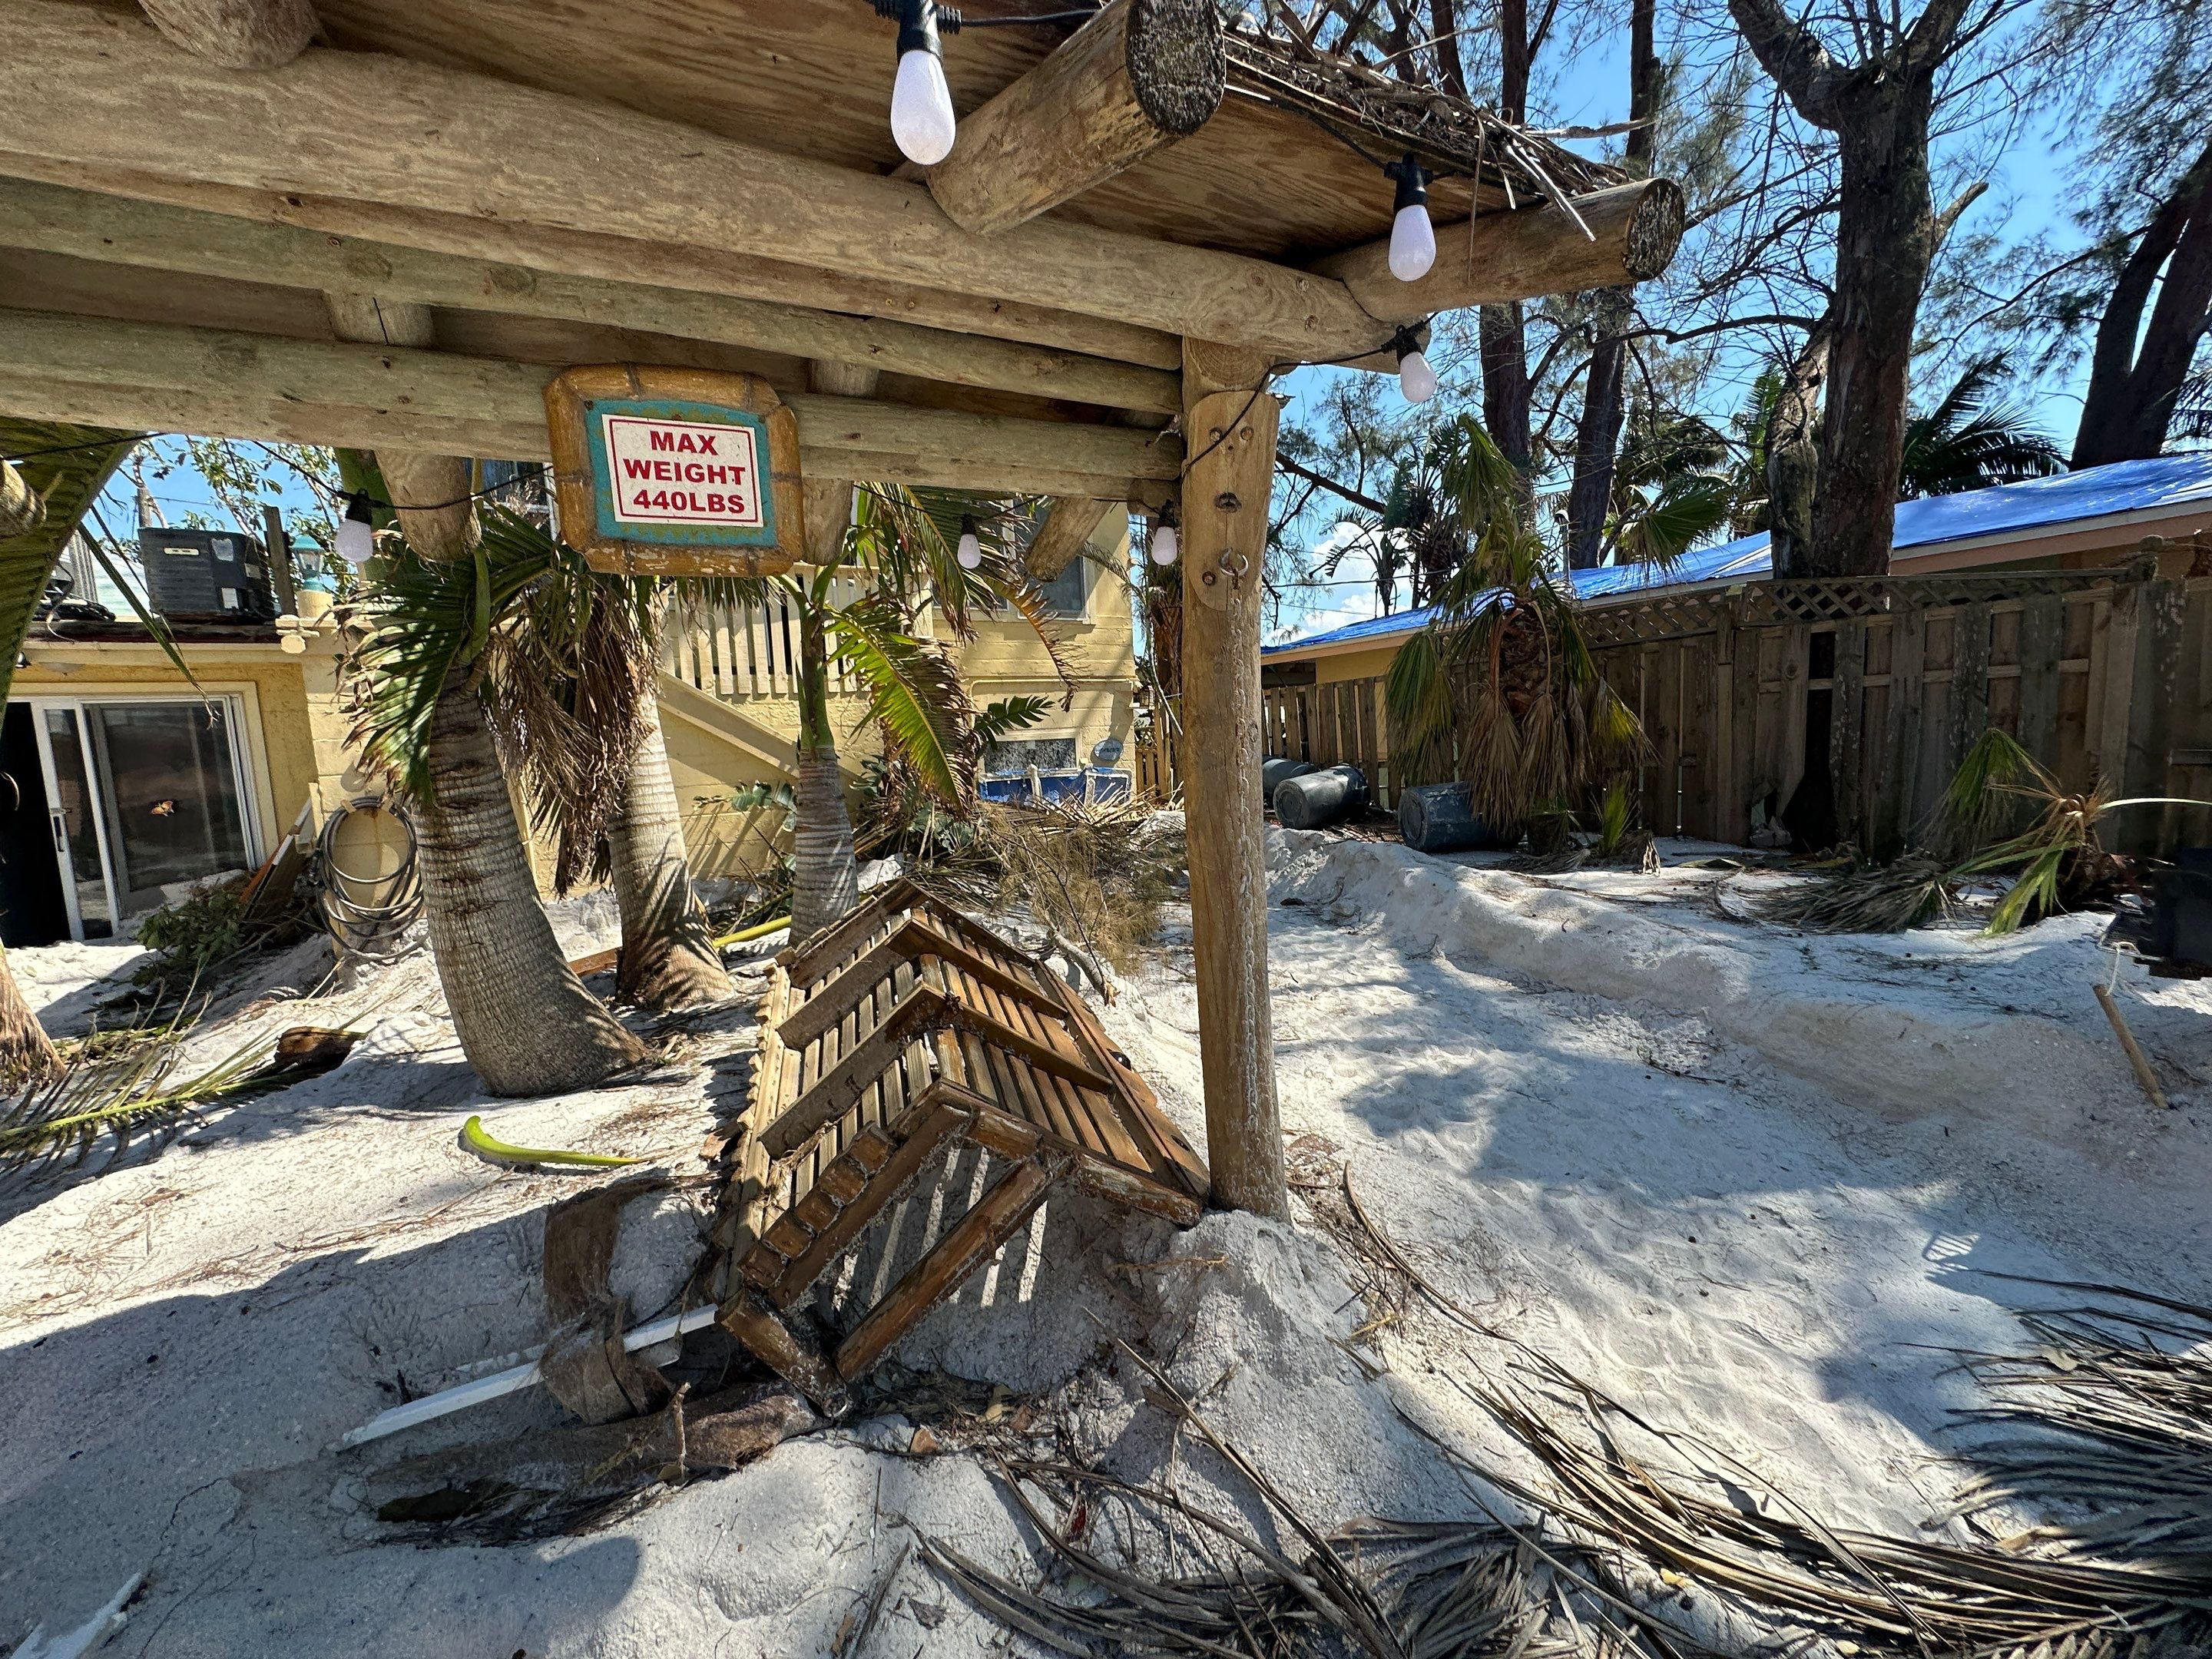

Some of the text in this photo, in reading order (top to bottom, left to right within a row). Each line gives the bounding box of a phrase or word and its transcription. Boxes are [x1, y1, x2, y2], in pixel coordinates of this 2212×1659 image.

[650, 431, 718, 455] MAX
[623, 459, 746, 485] WEIGHT
[633, 489, 745, 514] 440LBS
